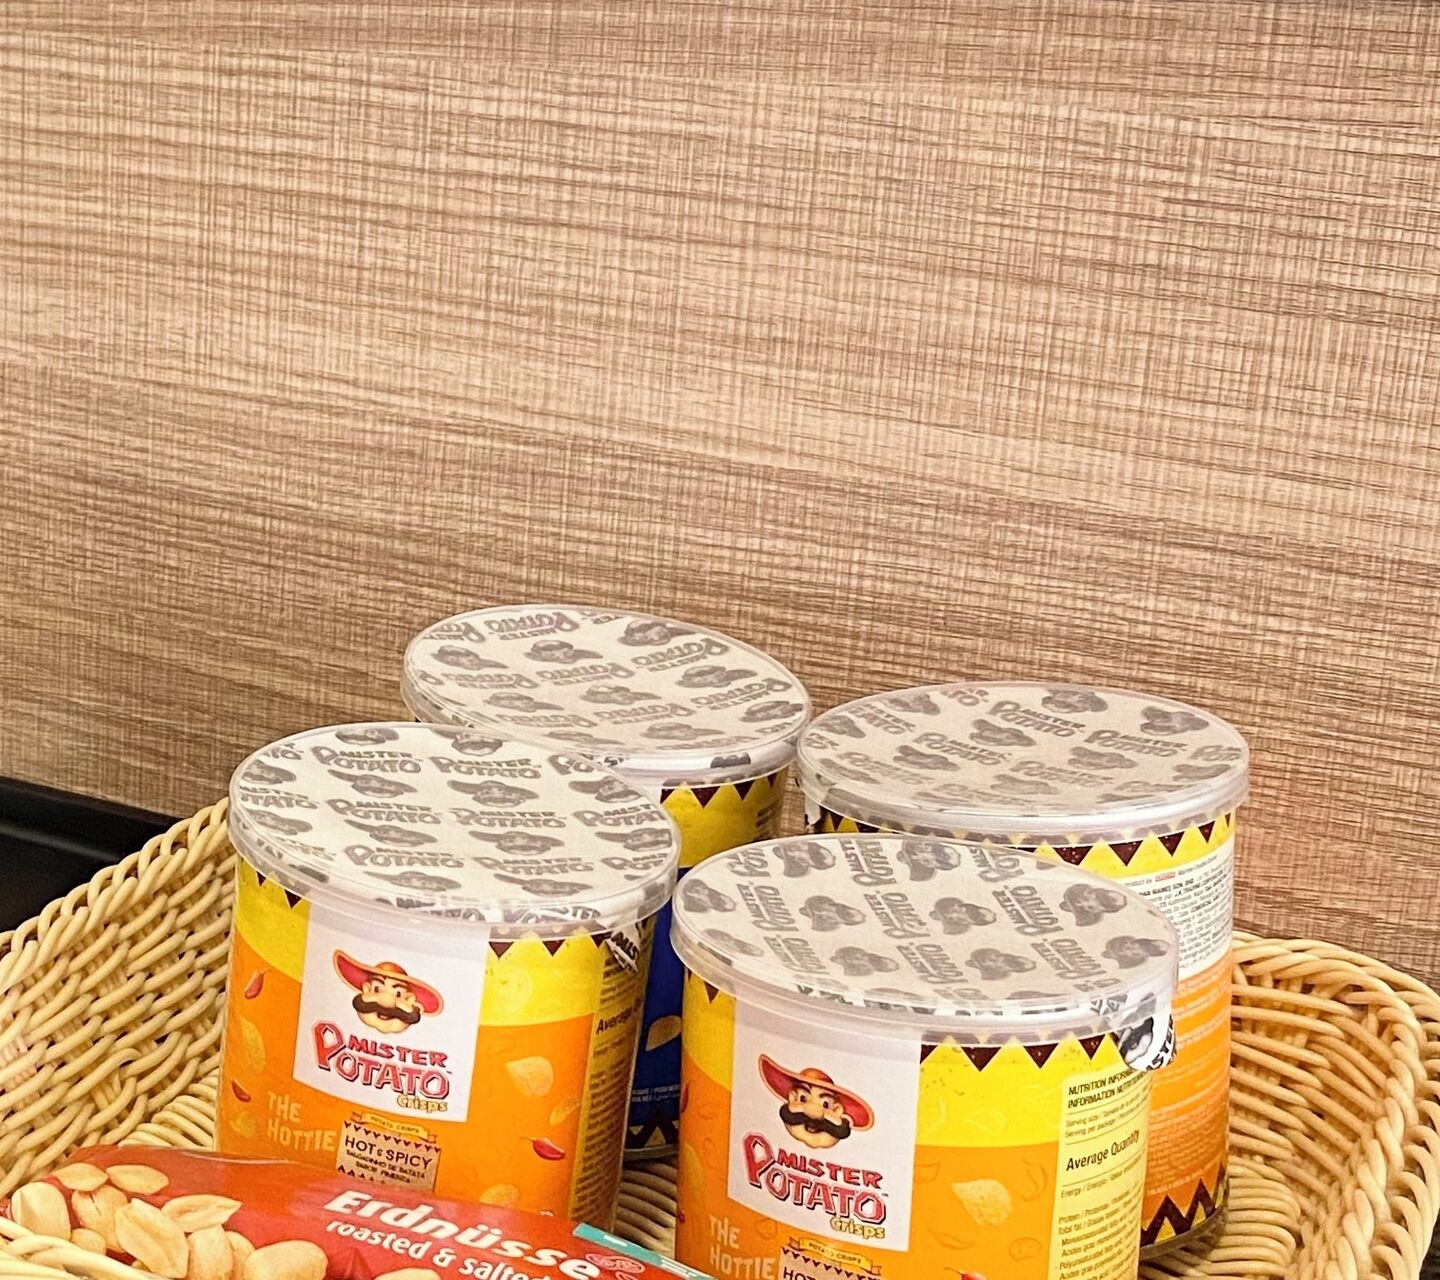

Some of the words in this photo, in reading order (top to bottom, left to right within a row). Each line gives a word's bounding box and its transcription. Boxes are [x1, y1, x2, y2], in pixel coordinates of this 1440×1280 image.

[987, 700, 1076, 737] POTATO
[1020, 708, 1086, 730] MISTER
[339, 751, 414, 760] MISTER
[1083, 730, 1179, 757] POTATO
[1118, 733, 1188, 749] MISTER
[310, 746, 422, 774] POTATO
[430, 756, 542, 779] POTATO
[457, 758, 532, 768] MISTER
[326, 799, 442, 825] POTATO
[356, 801, 432, 812] MISTER
[450, 808, 567, 828] POTATO
[479, 810, 556, 818] MISTER
[603, 803, 653, 817] MIST
[737, 884, 763, 925] MISTER
[751, 884, 799, 932] POTATO
[992, 890, 1029, 931] MISTER
[1011, 885, 1065, 937] POTATO
[312, 1021, 450, 1100] POTATO
[347, 1033, 448, 1068] MISTER
[1067, 1088, 1116, 1109] INFORMATION
[1068, 1077, 1107, 1096] NUTRITION
[267, 1090, 302, 1123] THE
[396, 1094, 448, 1114] Crisps
[267, 1118, 337, 1152] HOTTIE
[1066, 1148, 1109, 1171] Average
[1111, 1129, 1140, 1157] Quantity
[345, 1136, 377, 1155] HOT
[385, 1149, 433, 1170] SPICY
[746, 1135, 887, 1224] POTATO
[776, 1147, 883, 1191] MISTER
[709, 1214, 741, 1249] THE
[829, 1216, 886, 1240] Crisps
[326, 1219, 433, 1261] roasted
[432, 1244, 458, 1268] &
[710, 1245, 775, 1280] HOTTIE
